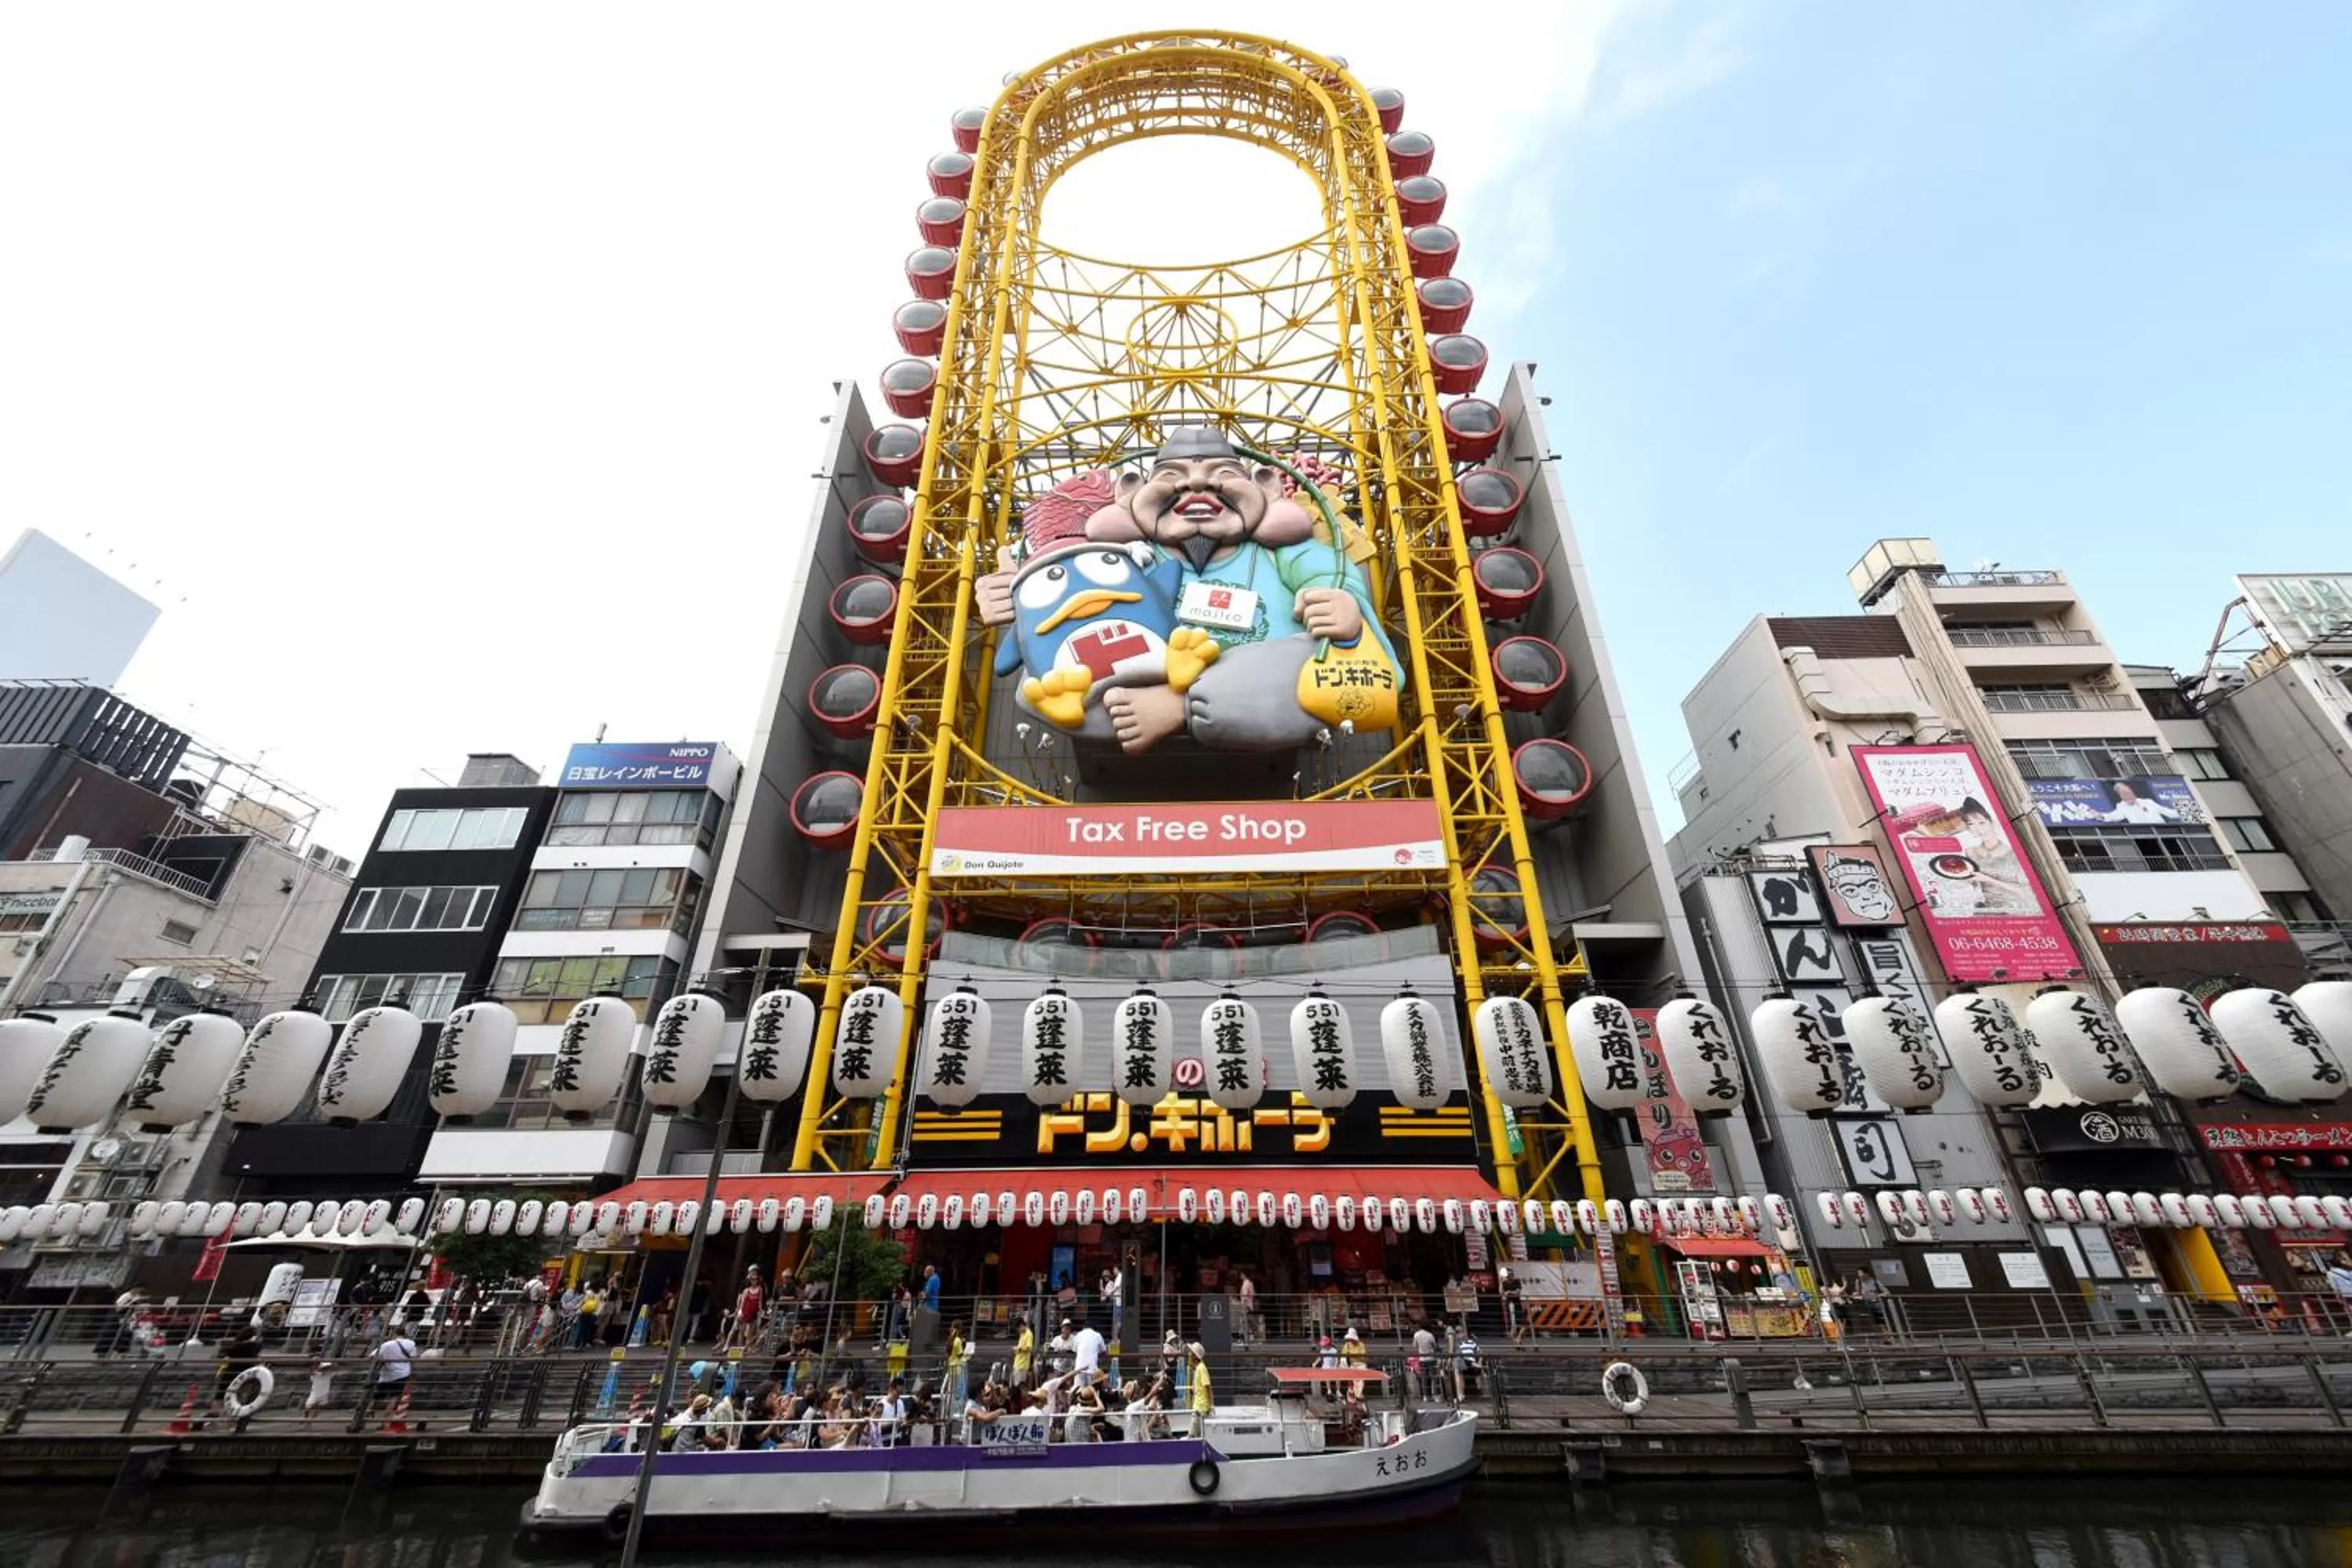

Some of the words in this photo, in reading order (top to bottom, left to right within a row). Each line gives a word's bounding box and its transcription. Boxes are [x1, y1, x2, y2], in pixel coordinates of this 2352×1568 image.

[669, 748, 710, 757] NIPPO
[567, 765, 703, 781] 日宝レインボービル
[1067, 815, 1125, 843] Tax
[1136, 815, 1209, 842] Free
[1220, 813, 1307, 845] Shop
[942, 999, 977, 1014] 551
[1035, 1000, 1067, 1015] 551
[1126, 1001, 1158, 1017] 551
[1211, 1004, 1245, 1022] 551
[1306, 1003, 1339, 1018] 551
[1594, 1003, 1639, 1090] 乾商店
[1688, 1003, 1738, 1100] くれおーる
[1793, 1004, 1843, 1102] くれおーる
[1882, 1000, 1935, 1090] くれおーる
[1965, 998, 2023, 1091] くれおーる
[2071, 996, 2133, 1085] くれおーる
[2270, 993, 2342, 1084] くれおーる
